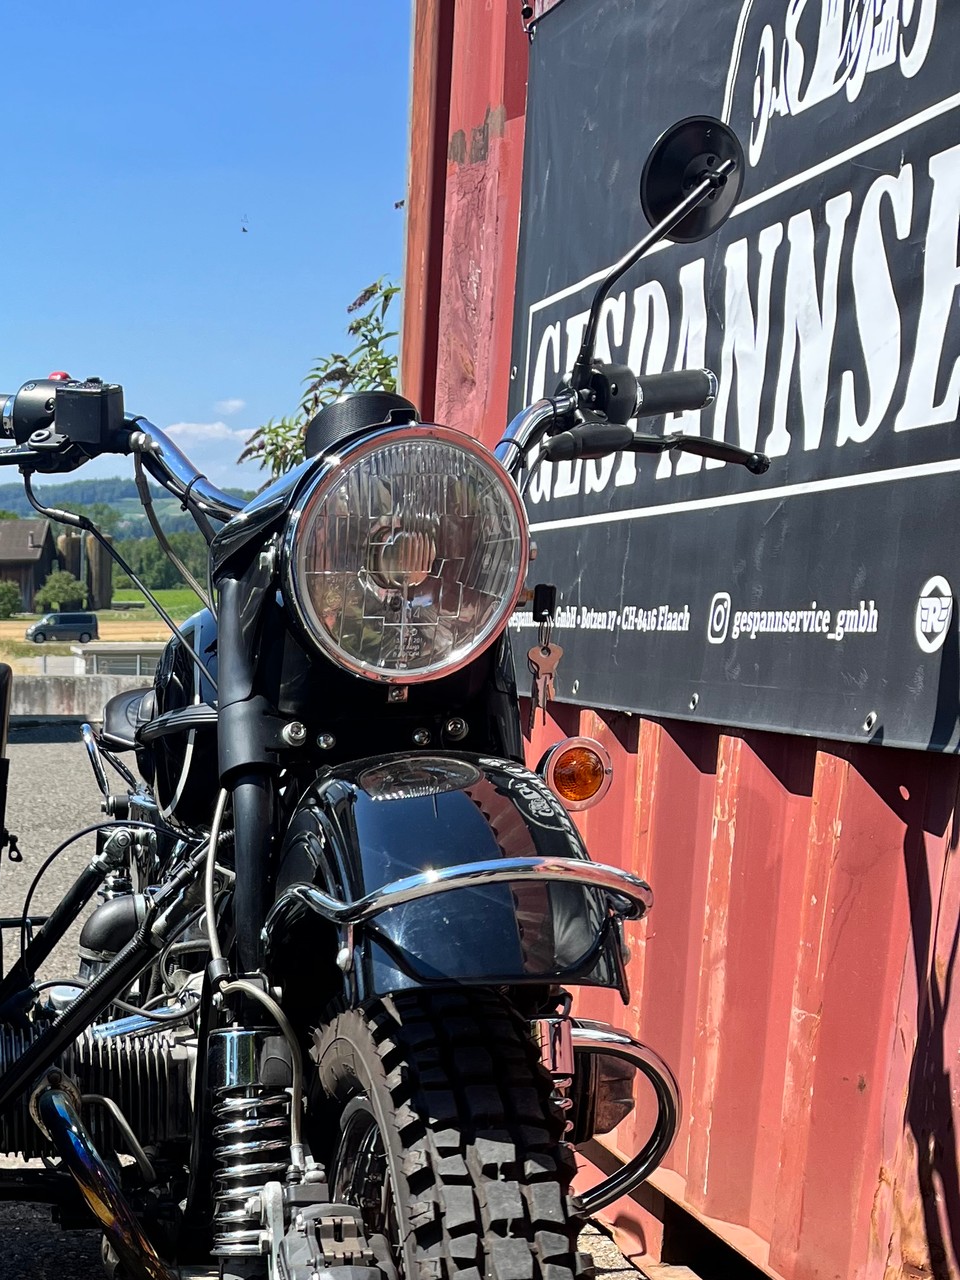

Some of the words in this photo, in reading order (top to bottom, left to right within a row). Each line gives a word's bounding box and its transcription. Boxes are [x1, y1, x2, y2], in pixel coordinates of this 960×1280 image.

[555, 606, 578, 628] GmbH
[580, 606, 607, 630] Botzen
[607, 610, 617, 632] 17
[621, 605, 657, 632] CH-8416
[656, 604, 690, 631] Flaach
[731, 600, 879, 641] gespannservice_gmbh
